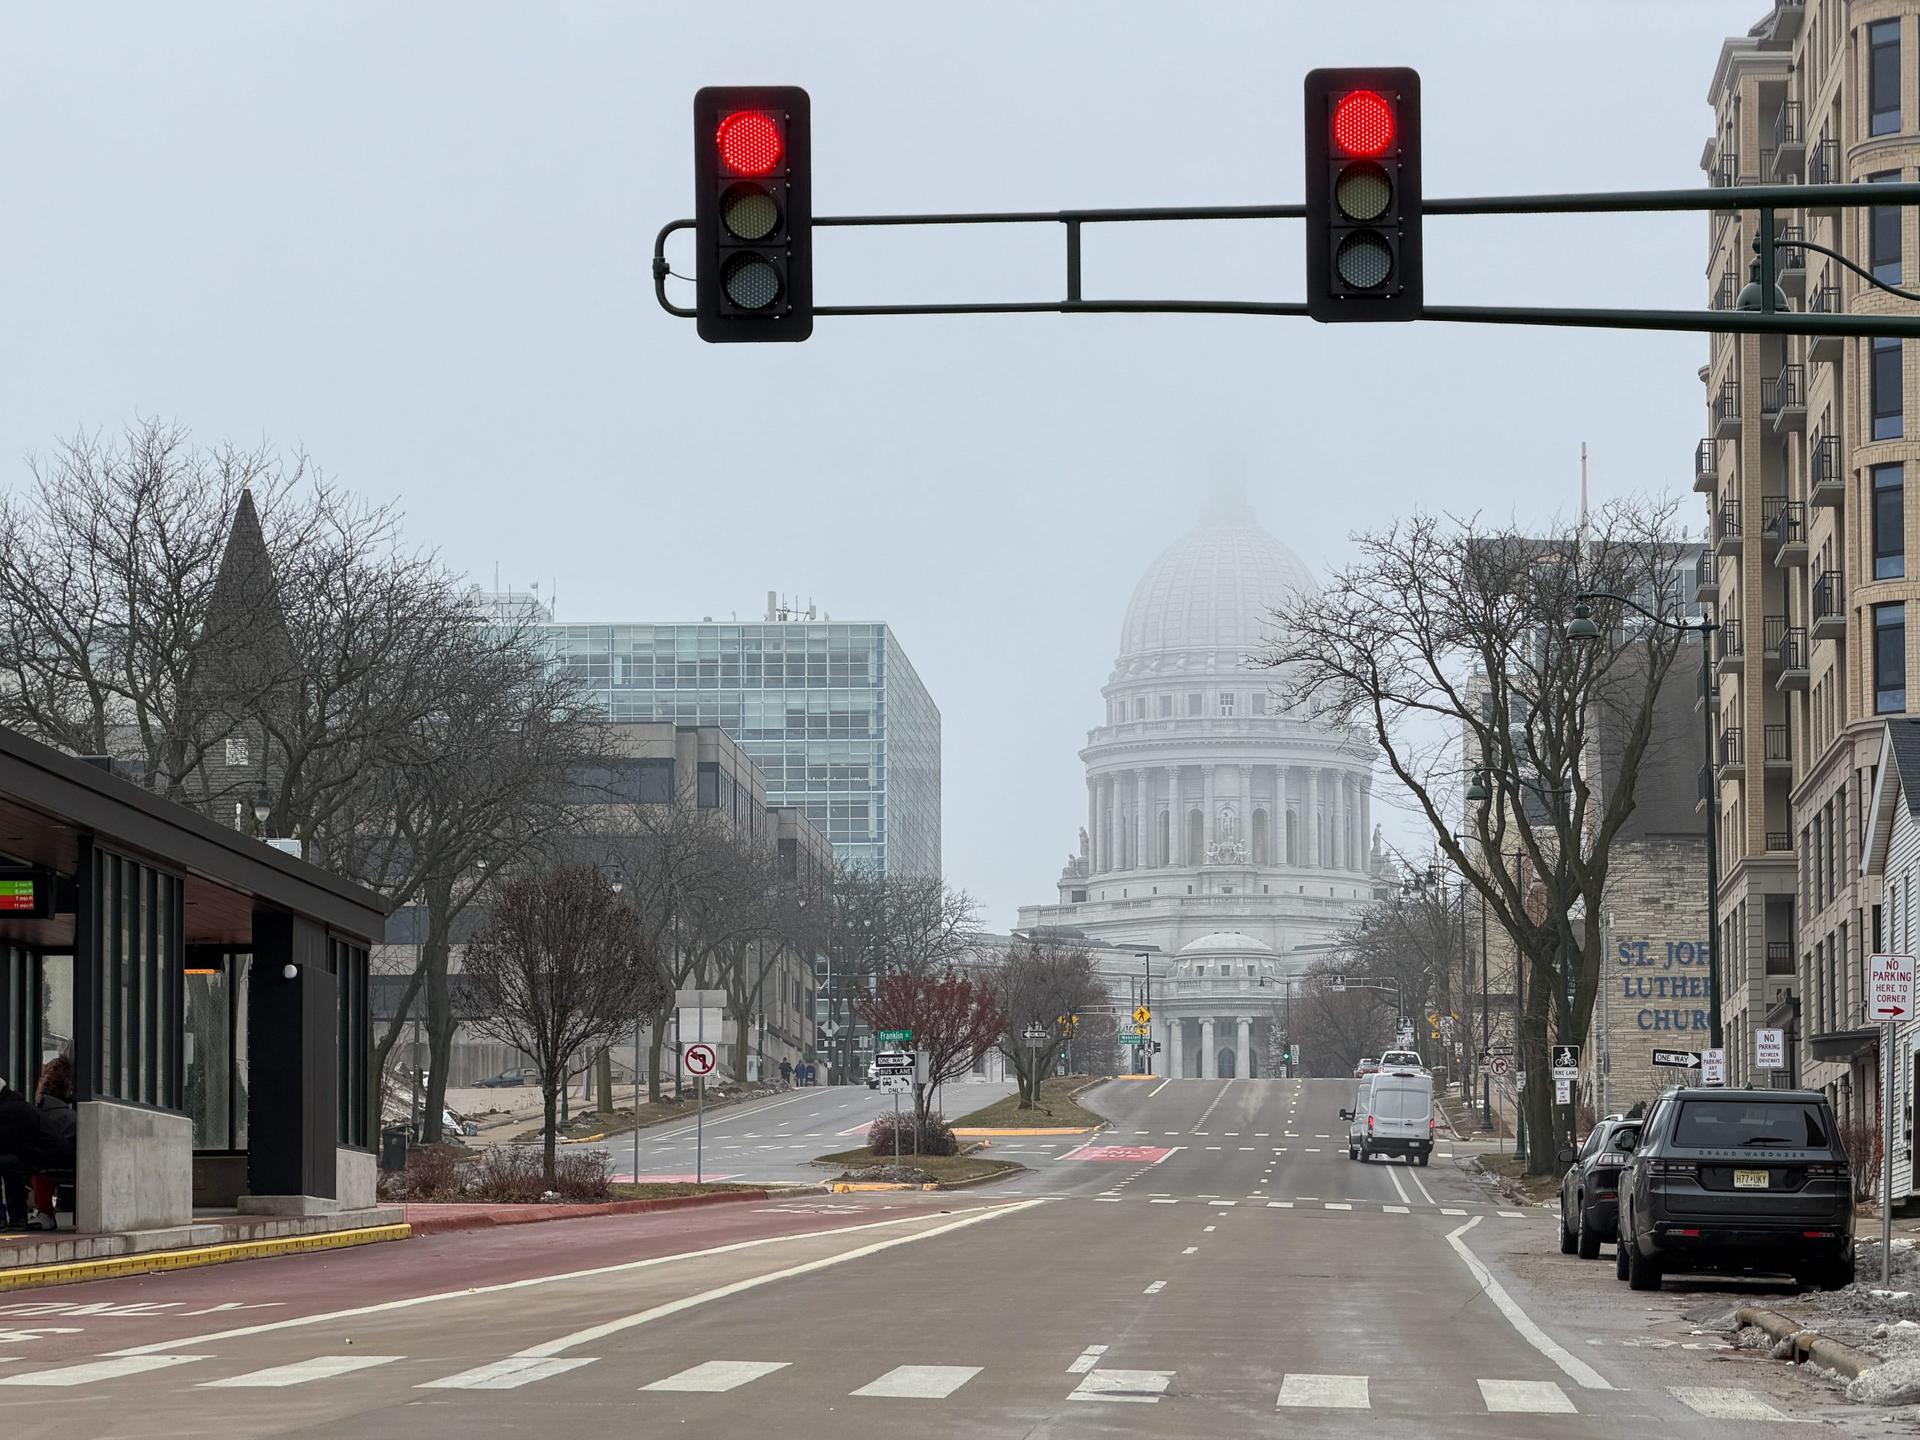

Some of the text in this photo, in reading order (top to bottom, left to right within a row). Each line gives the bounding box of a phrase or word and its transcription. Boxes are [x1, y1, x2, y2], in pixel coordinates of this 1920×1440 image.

[1619, 942, 1654, 966] ST.
[1886, 960, 1899, 970] NO
[1873, 971, 1912, 982] PARKING
[1876, 984, 1908, 993] HERE TO
[1876, 994, 1906, 1003] CORNER
[880, 1031, 904, 1040] Franklin
[1764, 1034, 1775, 1043] NO
[1656, 1054, 1688, 1063] ONE WAY
[1708, 1051, 1717, 1059] NO
